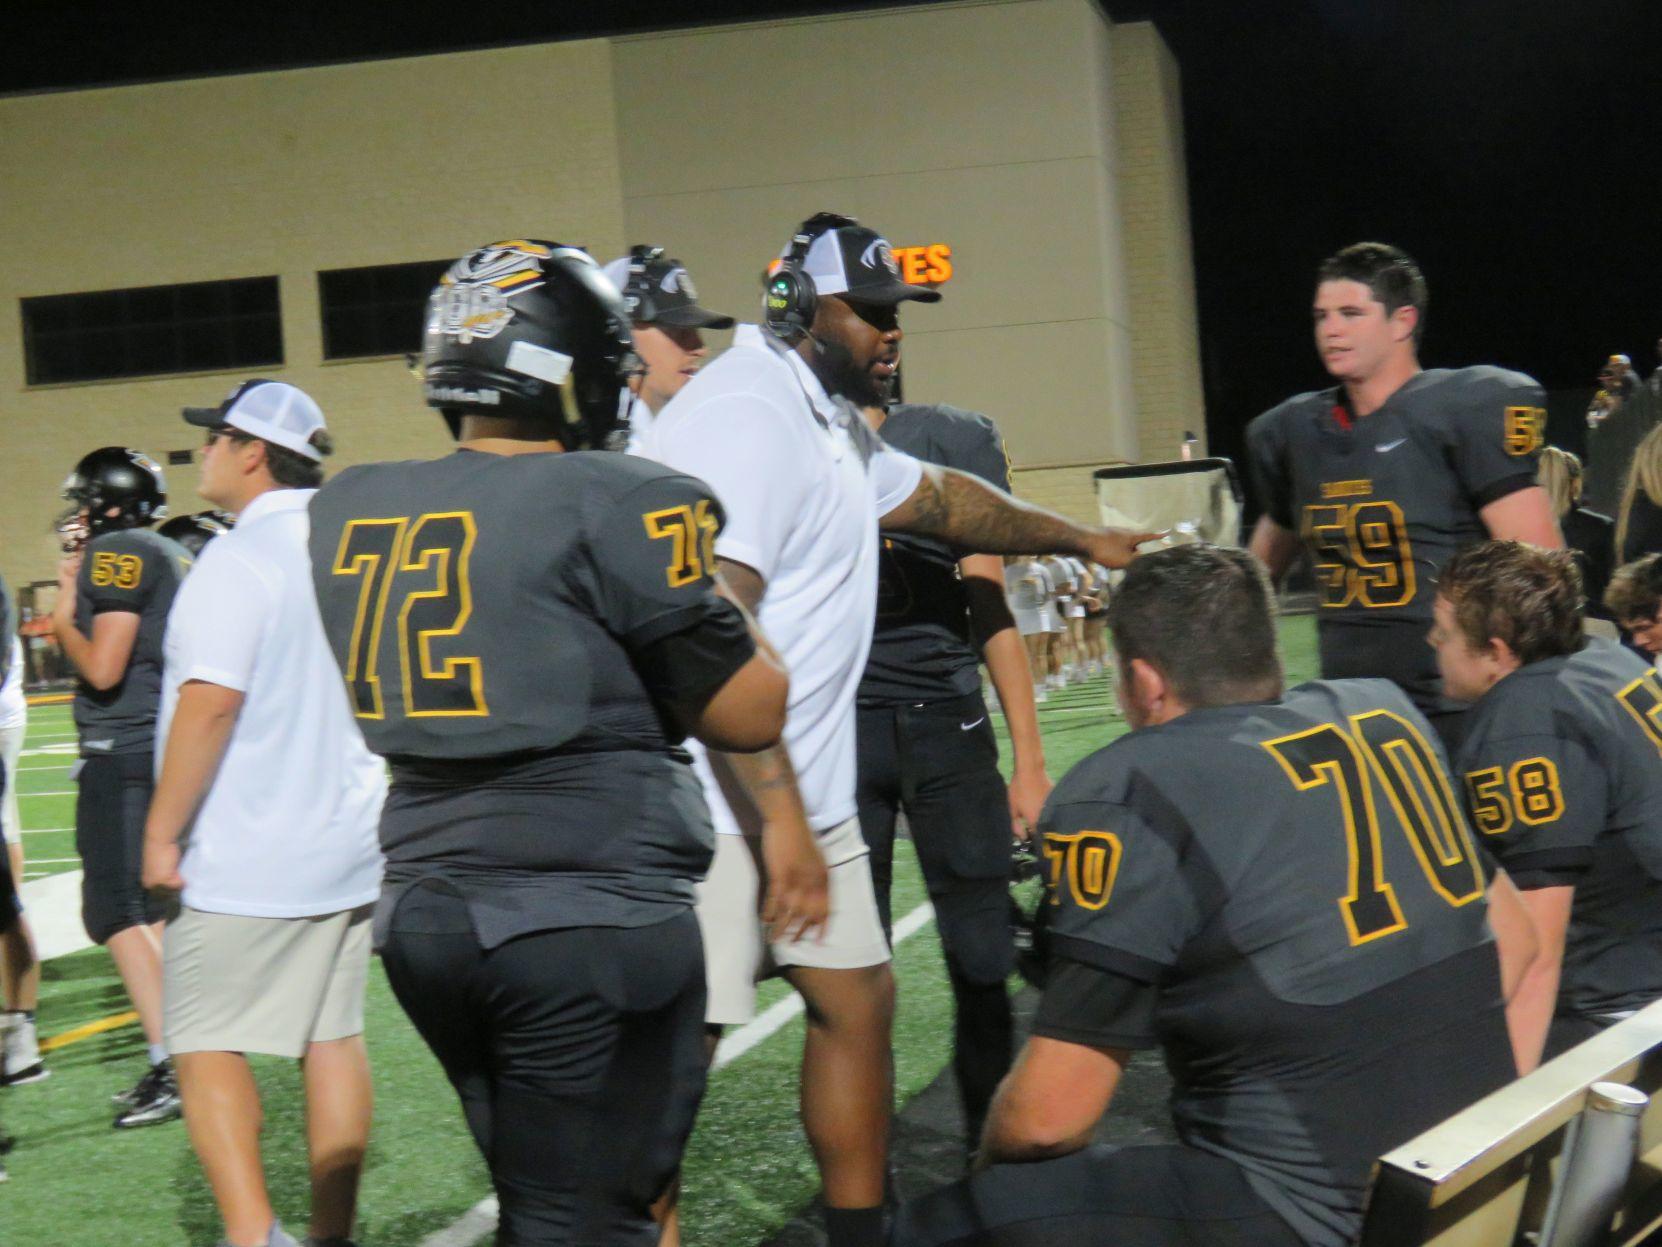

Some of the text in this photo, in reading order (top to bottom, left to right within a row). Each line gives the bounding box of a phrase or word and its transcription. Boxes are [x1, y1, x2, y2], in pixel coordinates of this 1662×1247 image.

[90, 552, 143, 589] 53
[1302, 501, 1417, 608] 59
[332, 511, 490, 720] 72
[1259, 709, 1486, 946] 70
[1464, 757, 1565, 835] 58
[1042, 830, 1123, 910] 70
